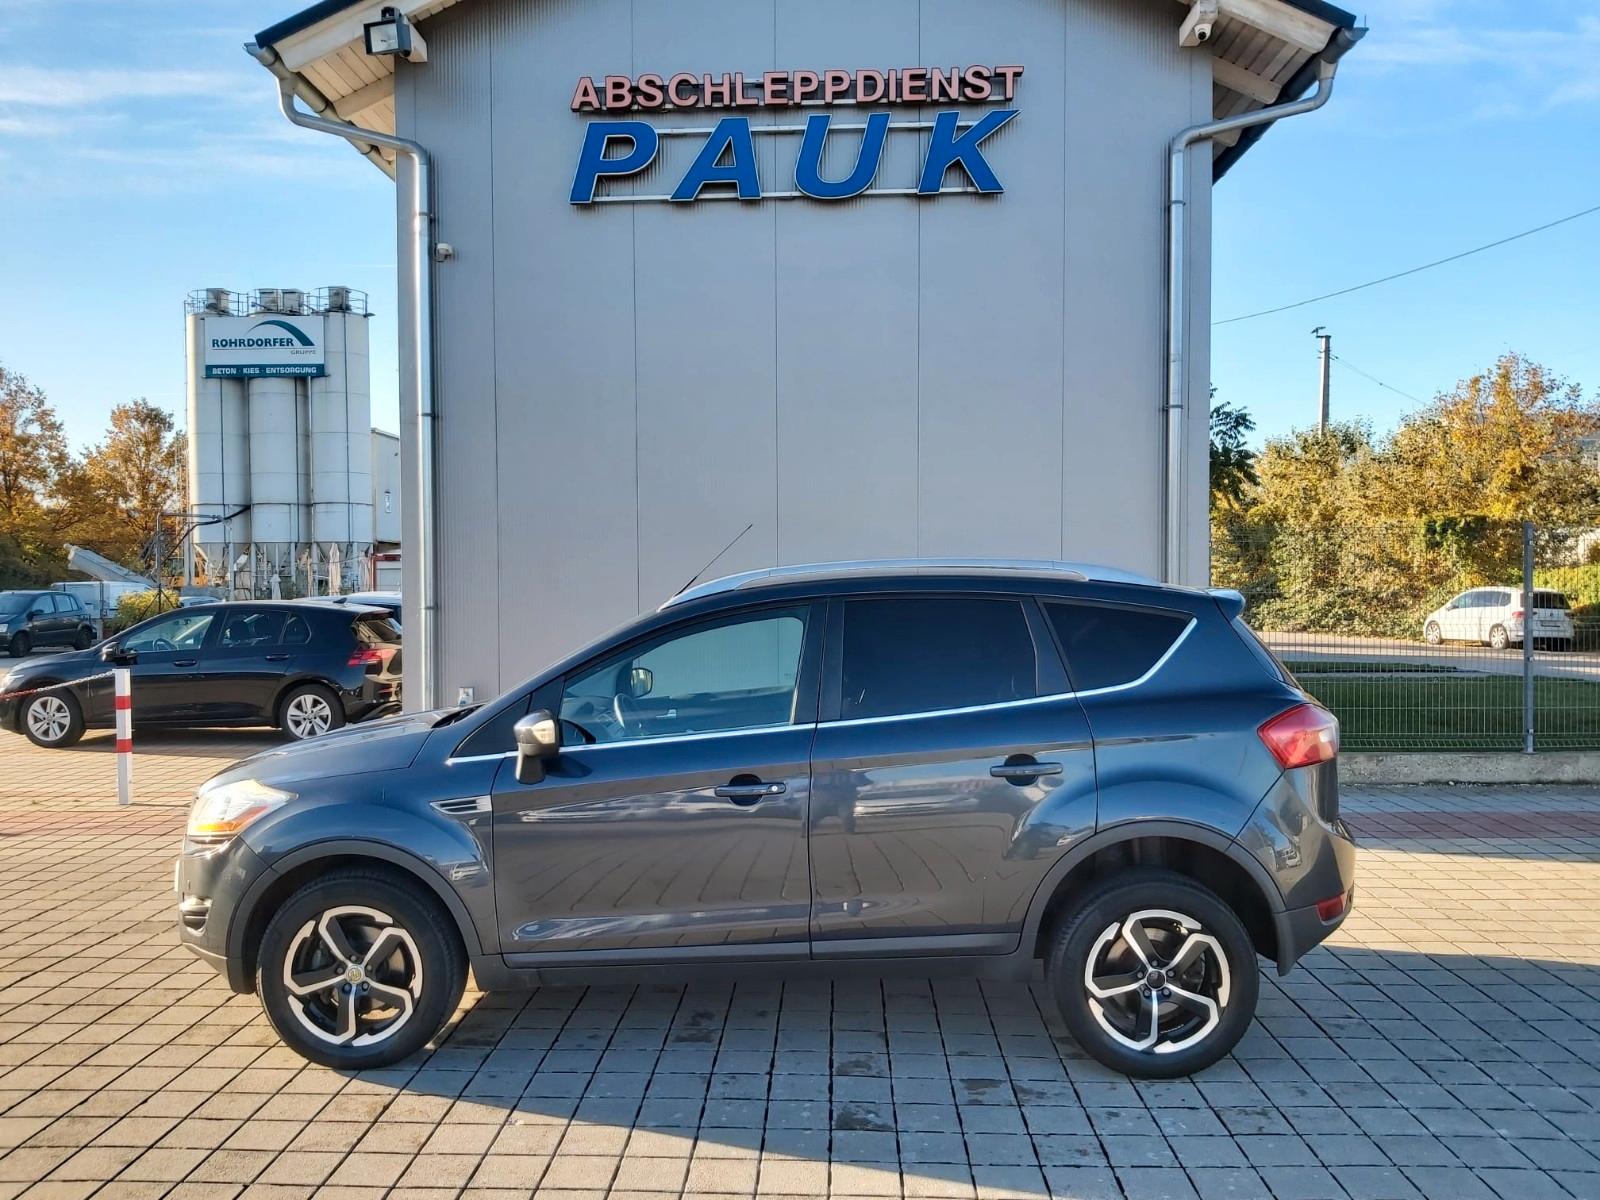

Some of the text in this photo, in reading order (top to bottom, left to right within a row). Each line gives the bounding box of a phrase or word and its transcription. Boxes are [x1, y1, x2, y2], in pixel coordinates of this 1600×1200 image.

[571, 65, 1024, 111] ABSCHLEPPDIENST
[569, 109, 1021, 204] PAUK
[212, 338, 294, 348] ROHRDORFER
